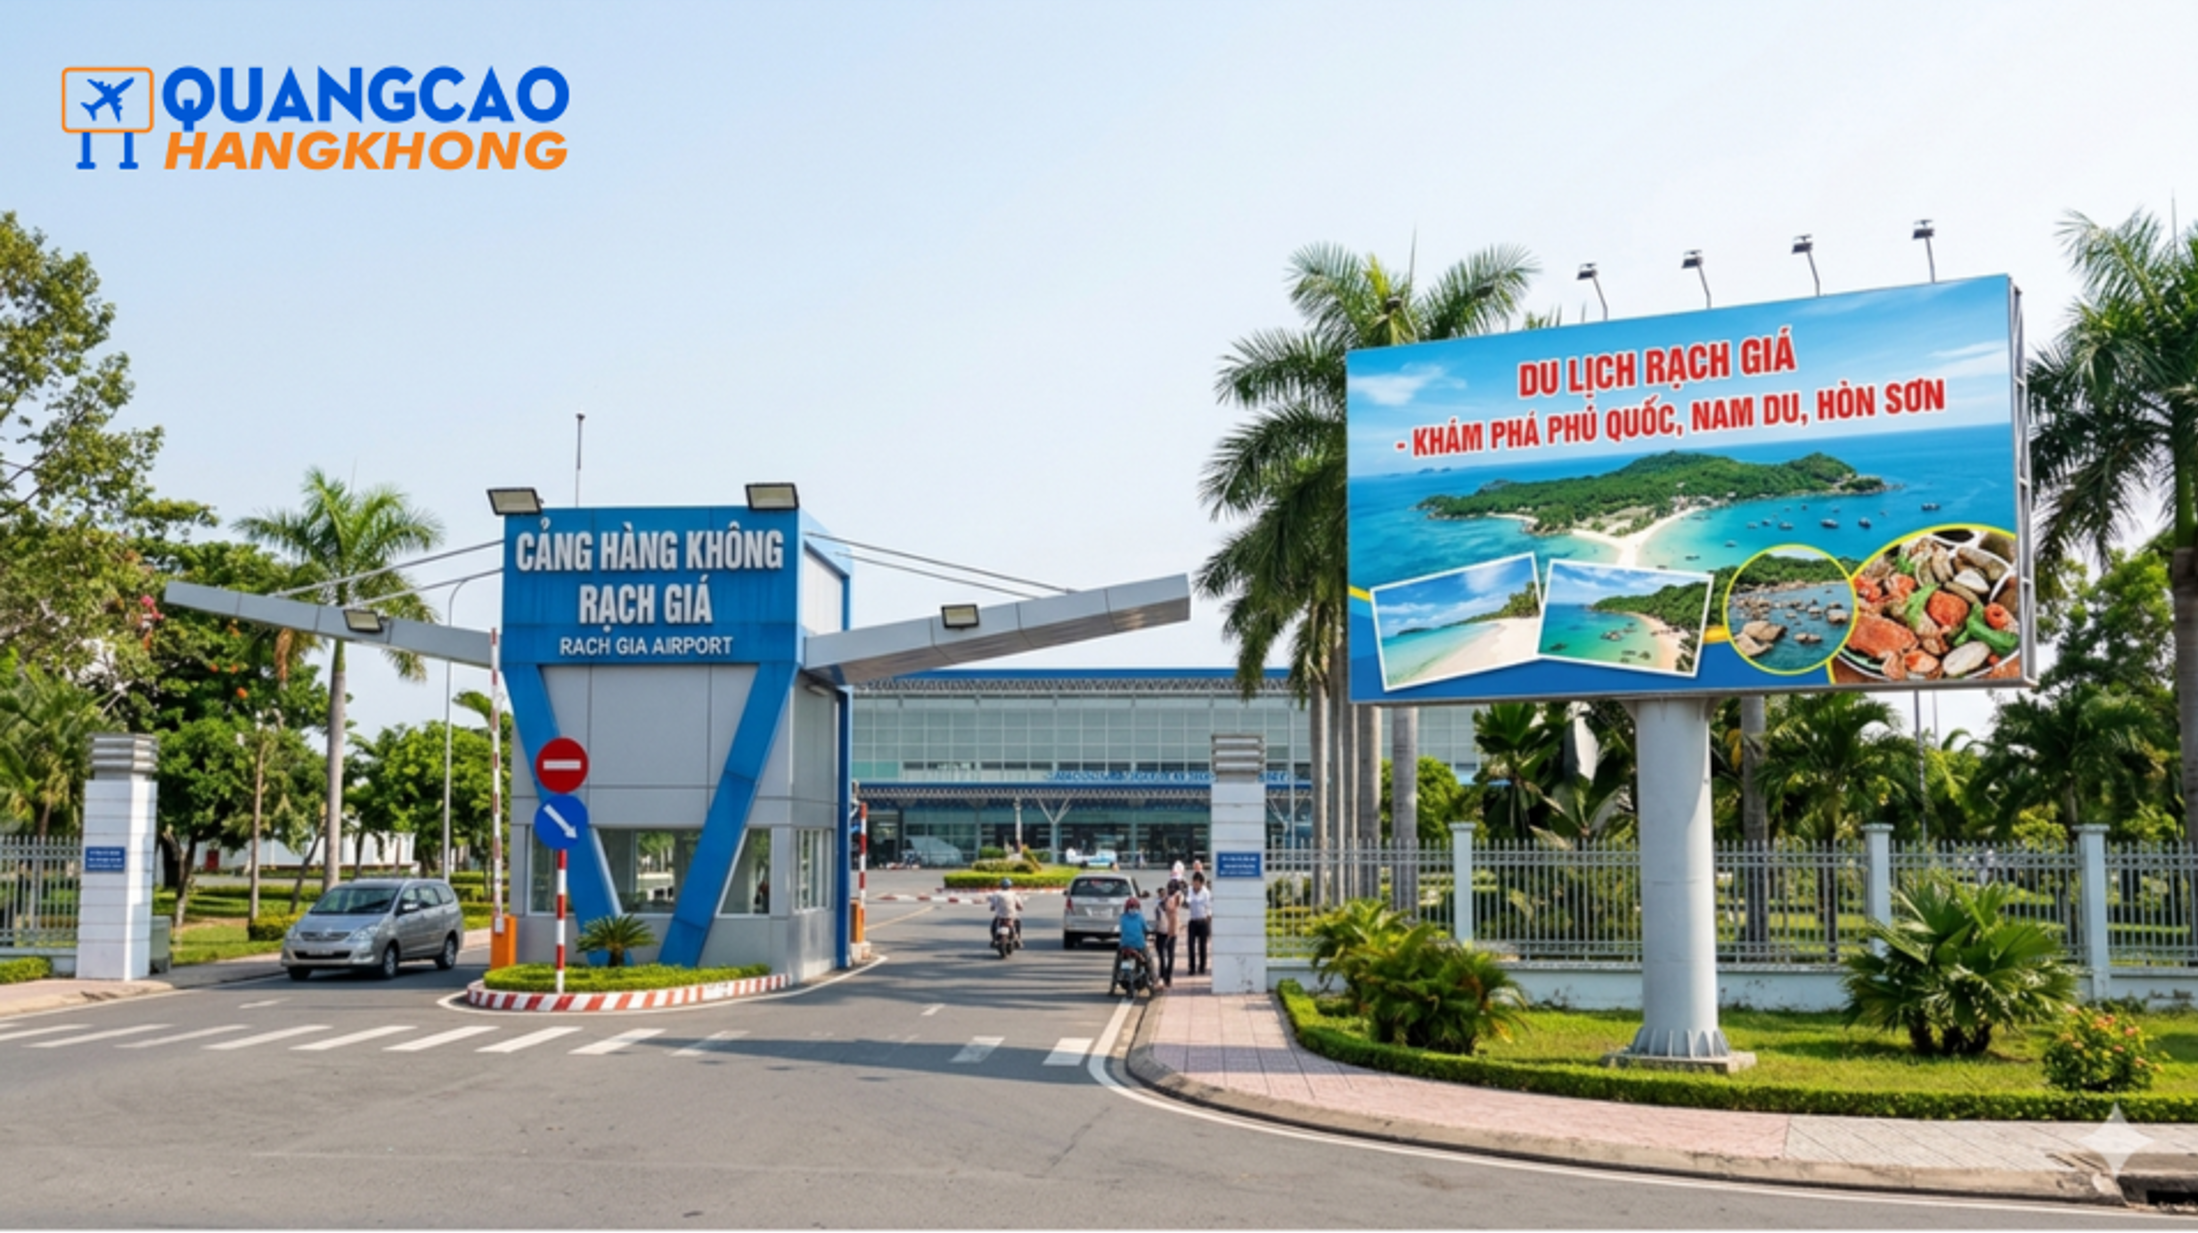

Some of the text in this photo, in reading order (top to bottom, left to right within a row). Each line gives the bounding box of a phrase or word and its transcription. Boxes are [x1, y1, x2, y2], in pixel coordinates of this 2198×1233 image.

[1519, 327, 1795, 398] DU LỊCH RẠCH GIÁ
[1413, 419, 1483, 457] KHÁM
[1491, 411, 1539, 449] PHÁ
[1606, 395, 1683, 441] QUỐC,
[1691, 397, 1753, 431] NAM
[1763, 393, 1808, 426] DU,
[1817, 381, 1875, 420] HÒN
[1885, 378, 1944, 414] SƠN
[516, 517, 784, 571] CẢNG HÀNG KHÔNG
[579, 575, 713, 632] RẠCH GIÁ
[560, 636, 733, 655] RACH GIA AIRPORT
